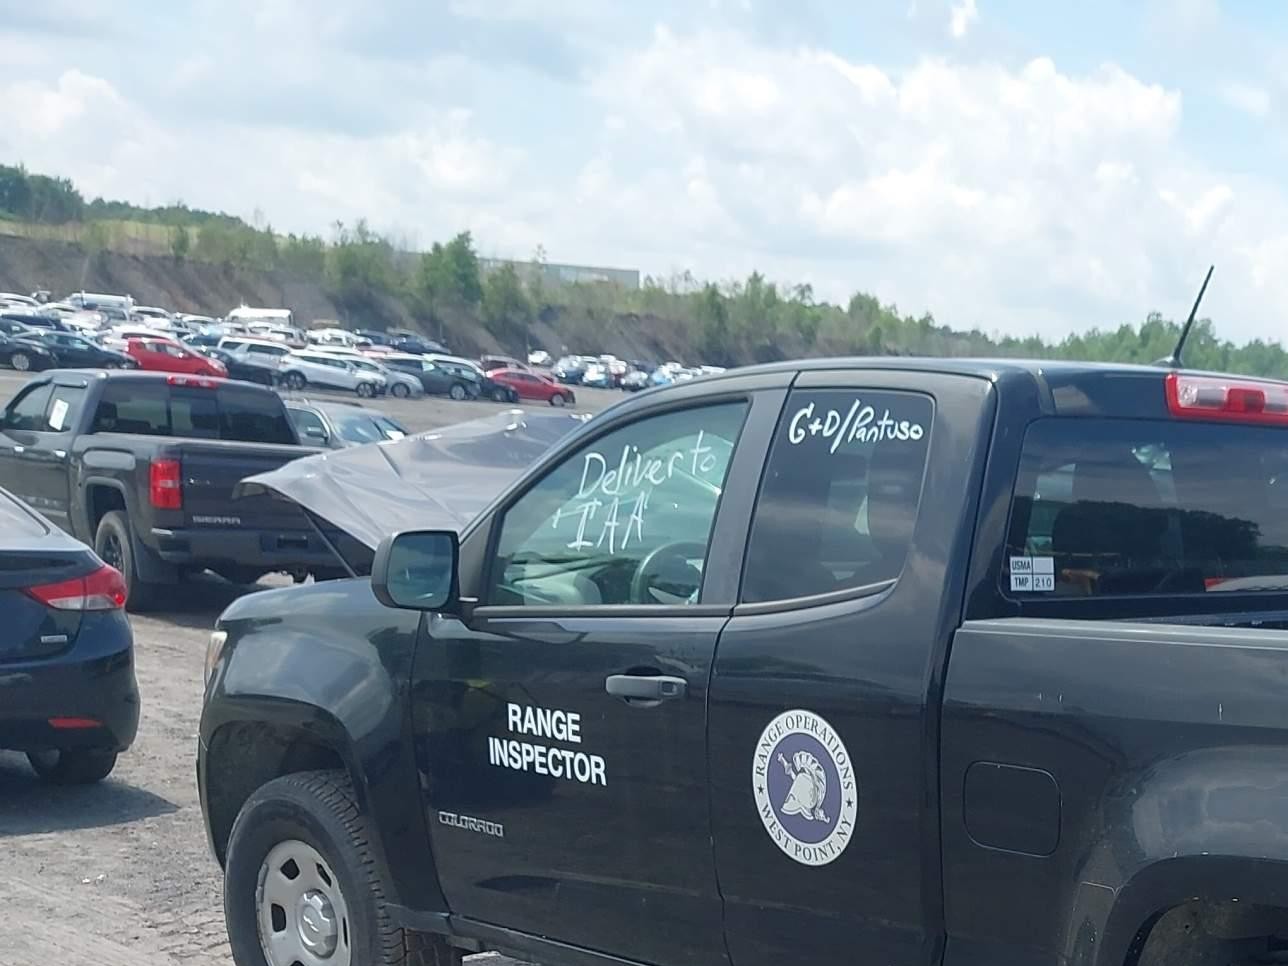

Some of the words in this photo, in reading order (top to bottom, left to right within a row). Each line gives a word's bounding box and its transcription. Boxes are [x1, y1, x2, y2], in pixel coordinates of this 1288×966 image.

[577, 445, 683, 498] Deliver
[690, 430, 716, 475] to
[552, 491, 648, 554] IAA
[1011, 560, 1031, 570] USMA
[1015, 577, 1029, 588] TMP
[1035, 576, 1052, 588] 210
[508, 703, 581, 743] RANGE
[488, 737, 607, 786] INSPECTOR
[755, 722, 783, 777] RANGE
[785, 714, 854, 790] OPERATIONS
[438, 811, 503, 837] COLORADO
[762, 804, 792, 849] WEST
[836, 815, 852, 842] NY
